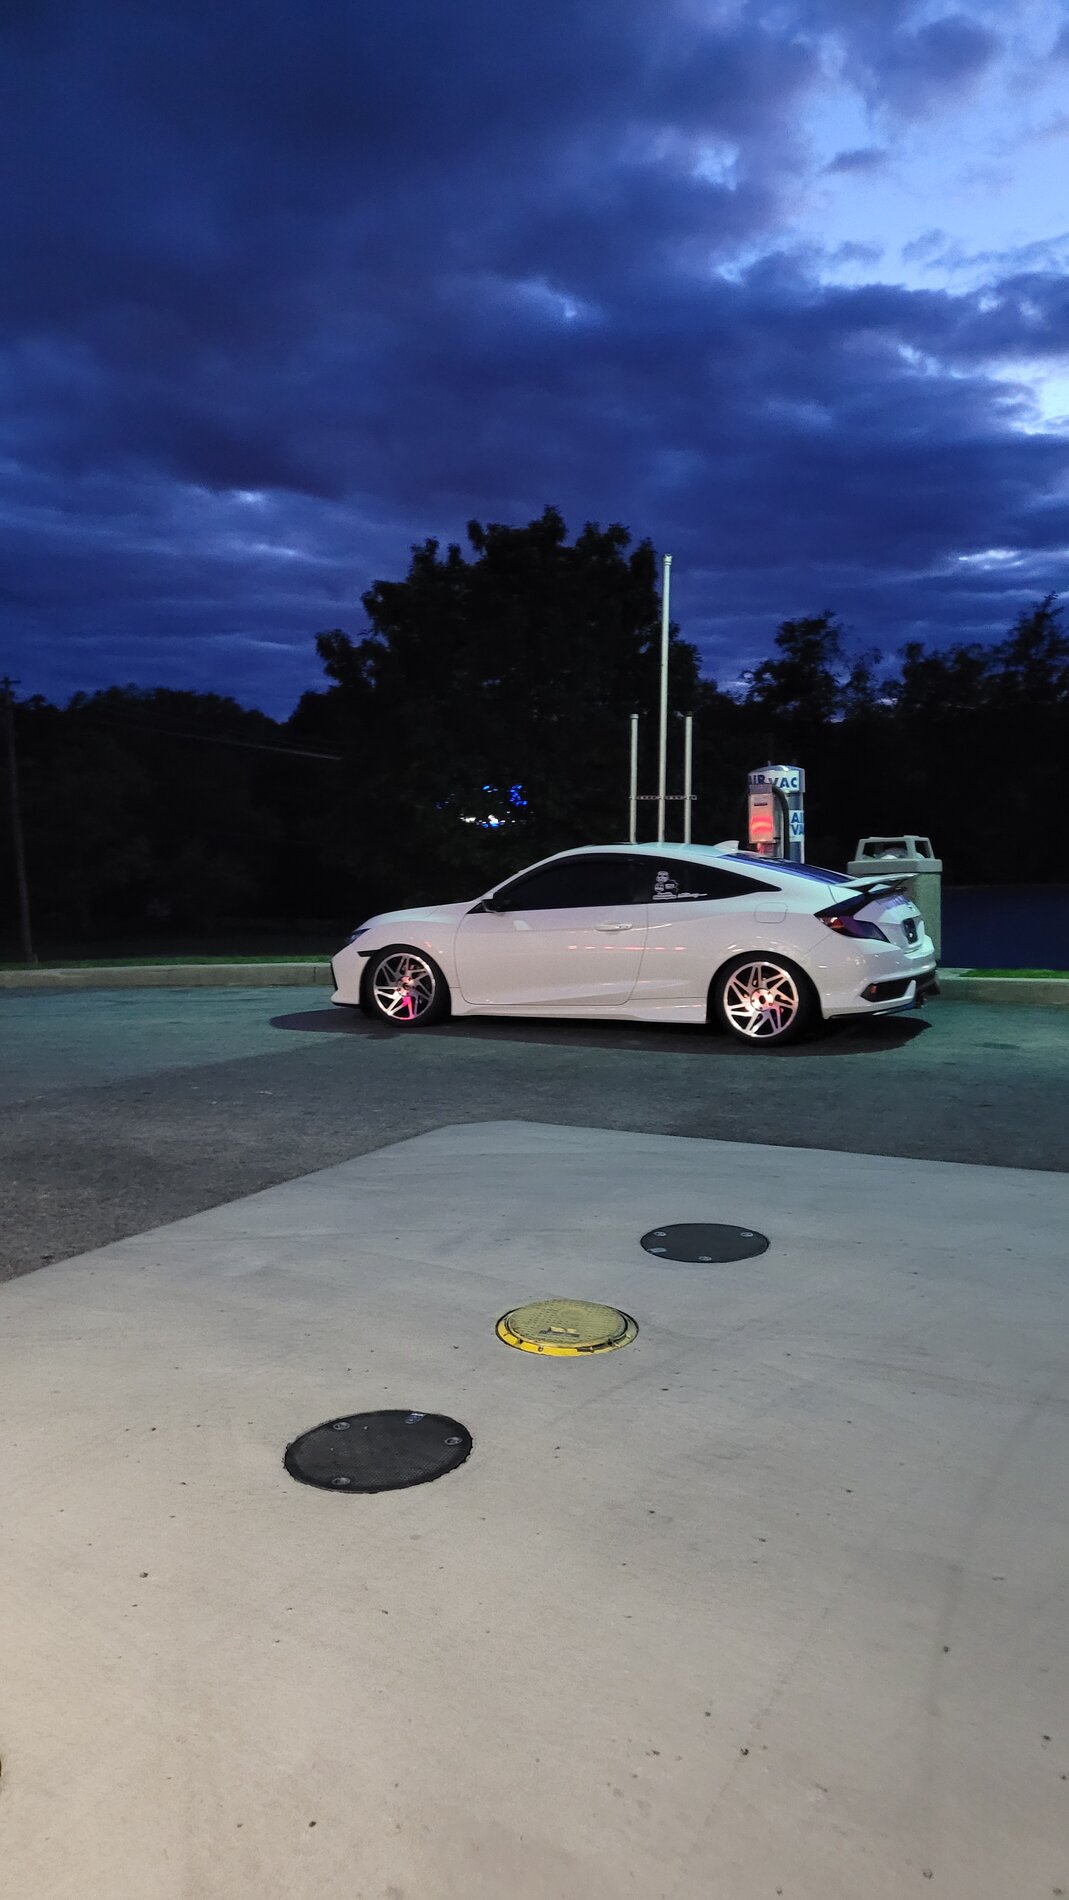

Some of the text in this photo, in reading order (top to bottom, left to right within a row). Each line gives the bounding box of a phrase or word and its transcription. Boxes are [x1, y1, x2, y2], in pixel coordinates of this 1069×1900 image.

[768, 777, 797, 788] VAC
[791, 812, 804, 823] AI
[790, 824, 804, 835] VA
